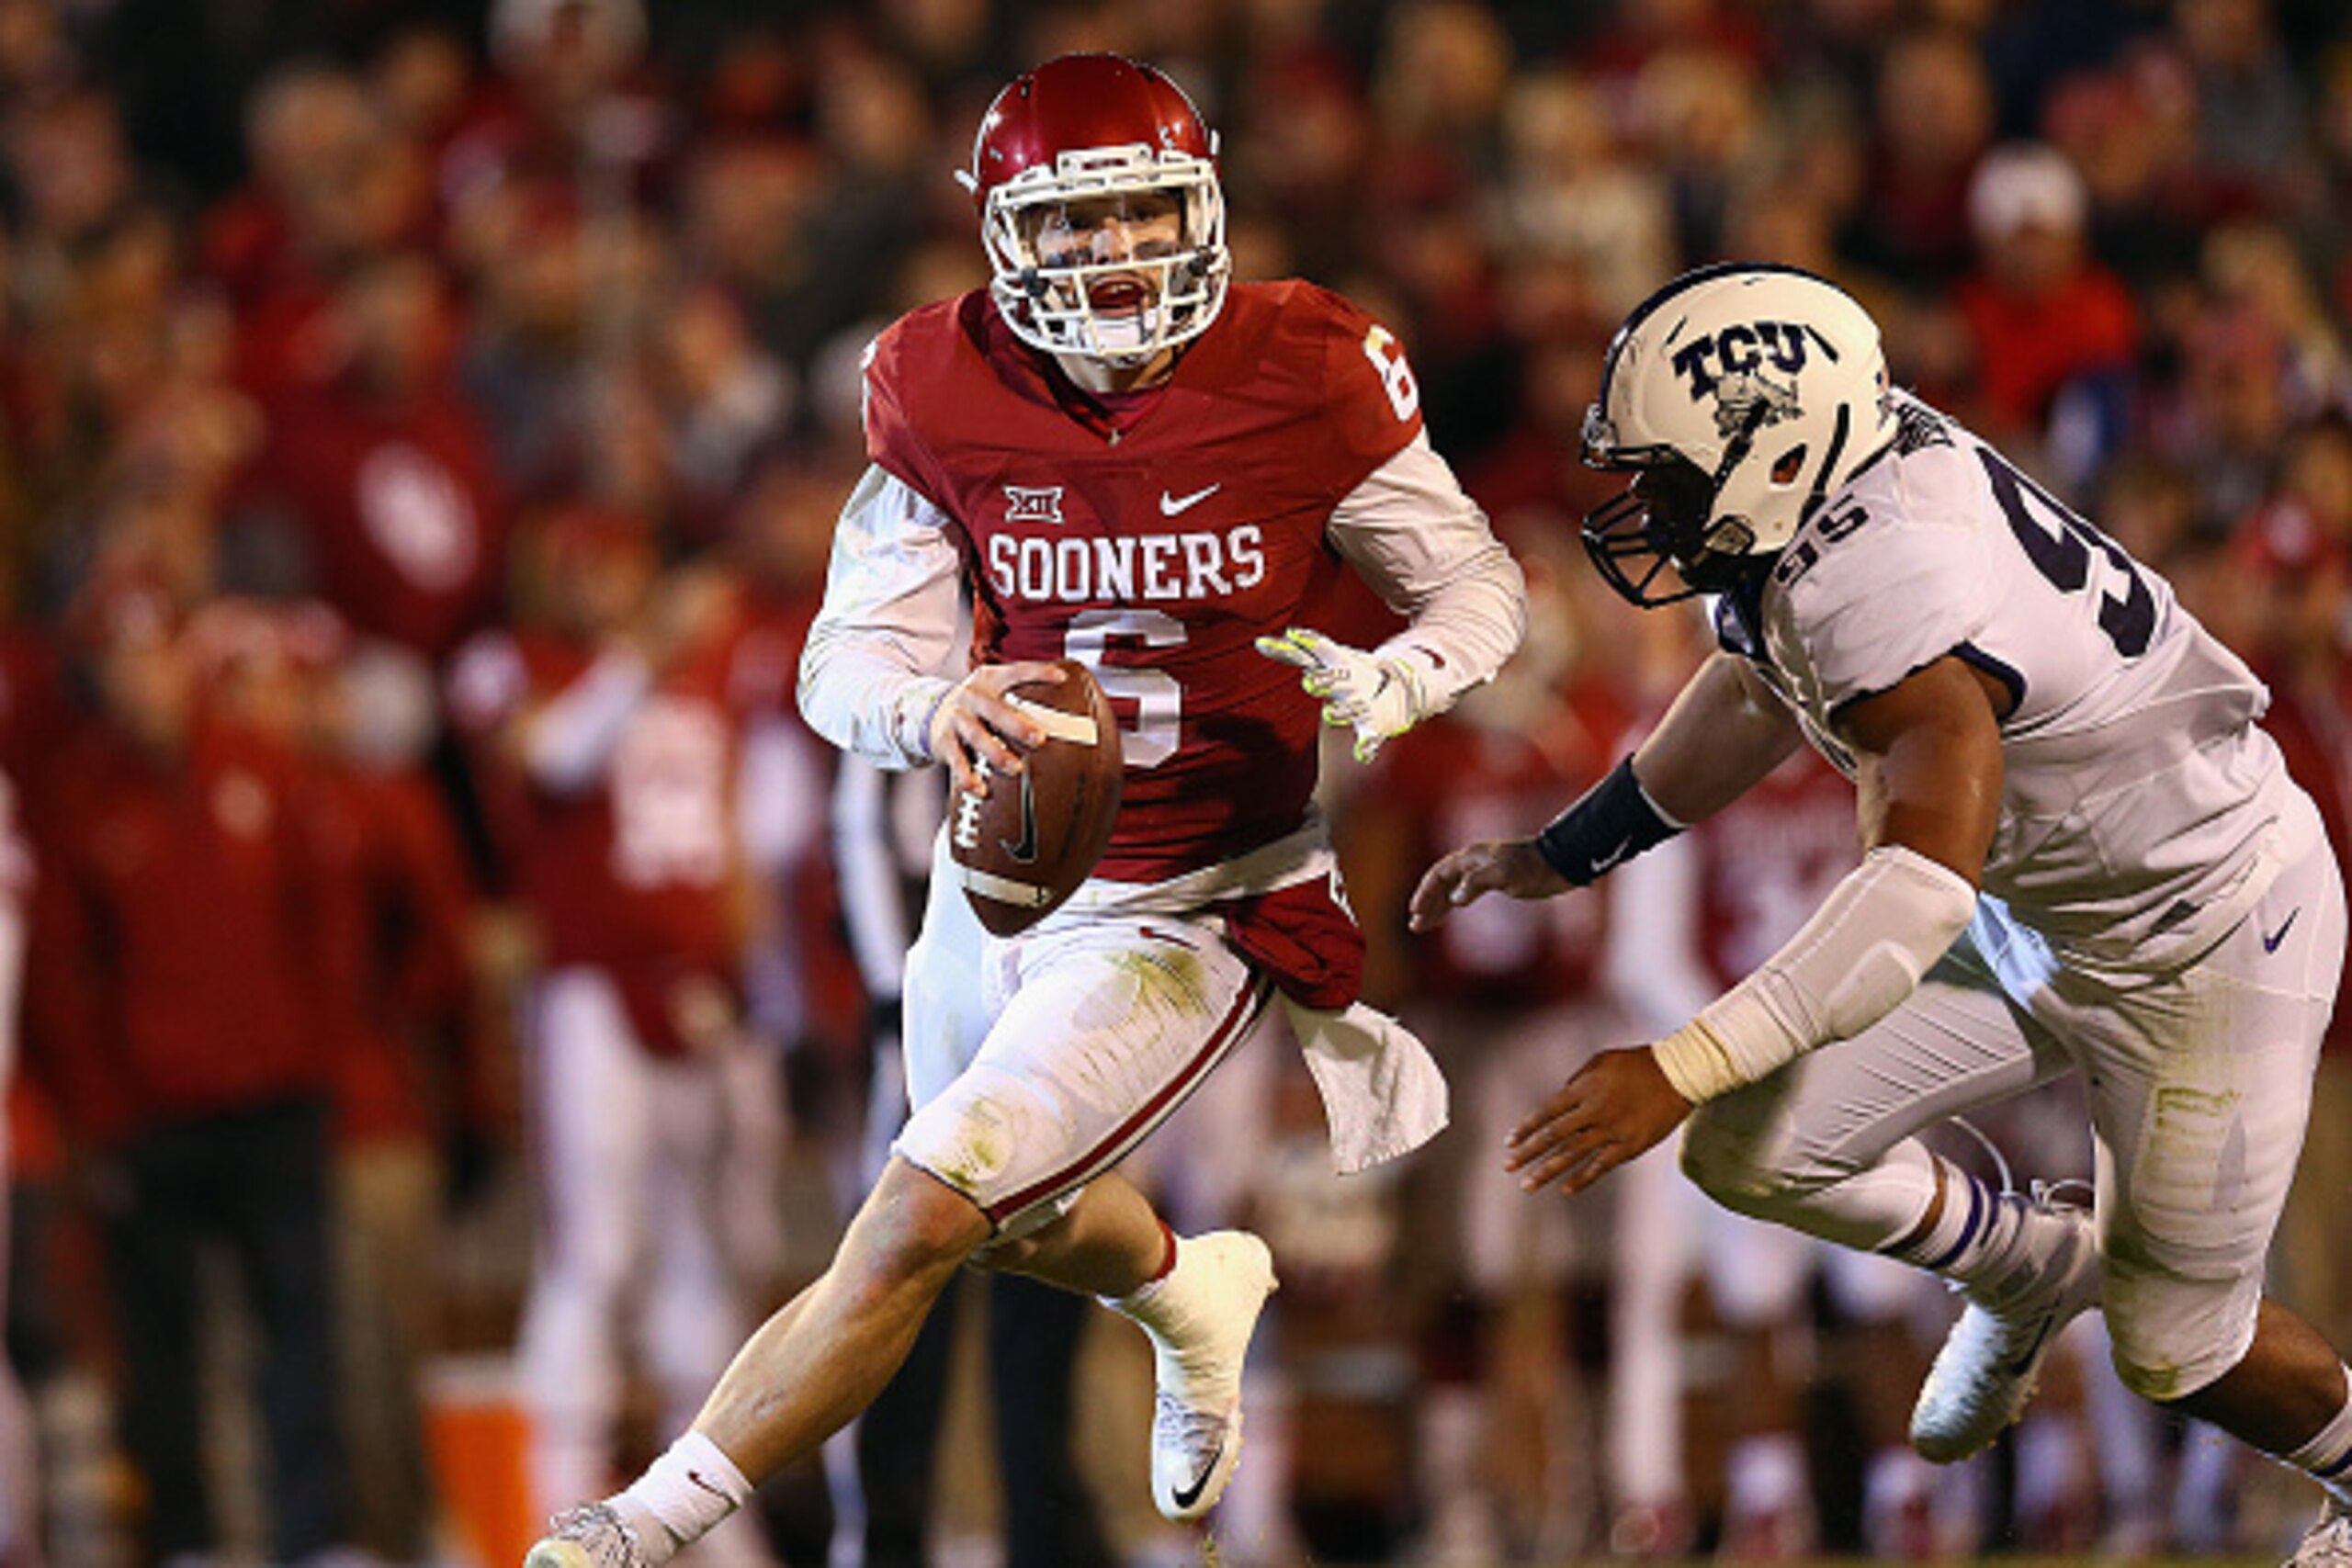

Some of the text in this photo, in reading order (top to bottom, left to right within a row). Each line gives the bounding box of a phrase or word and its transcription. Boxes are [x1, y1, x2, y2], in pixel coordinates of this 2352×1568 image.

[1363, 324, 1419, 422] 6
[1672, 321, 1807, 402] TCU
[989, 525, 1265, 602] SOONERS
